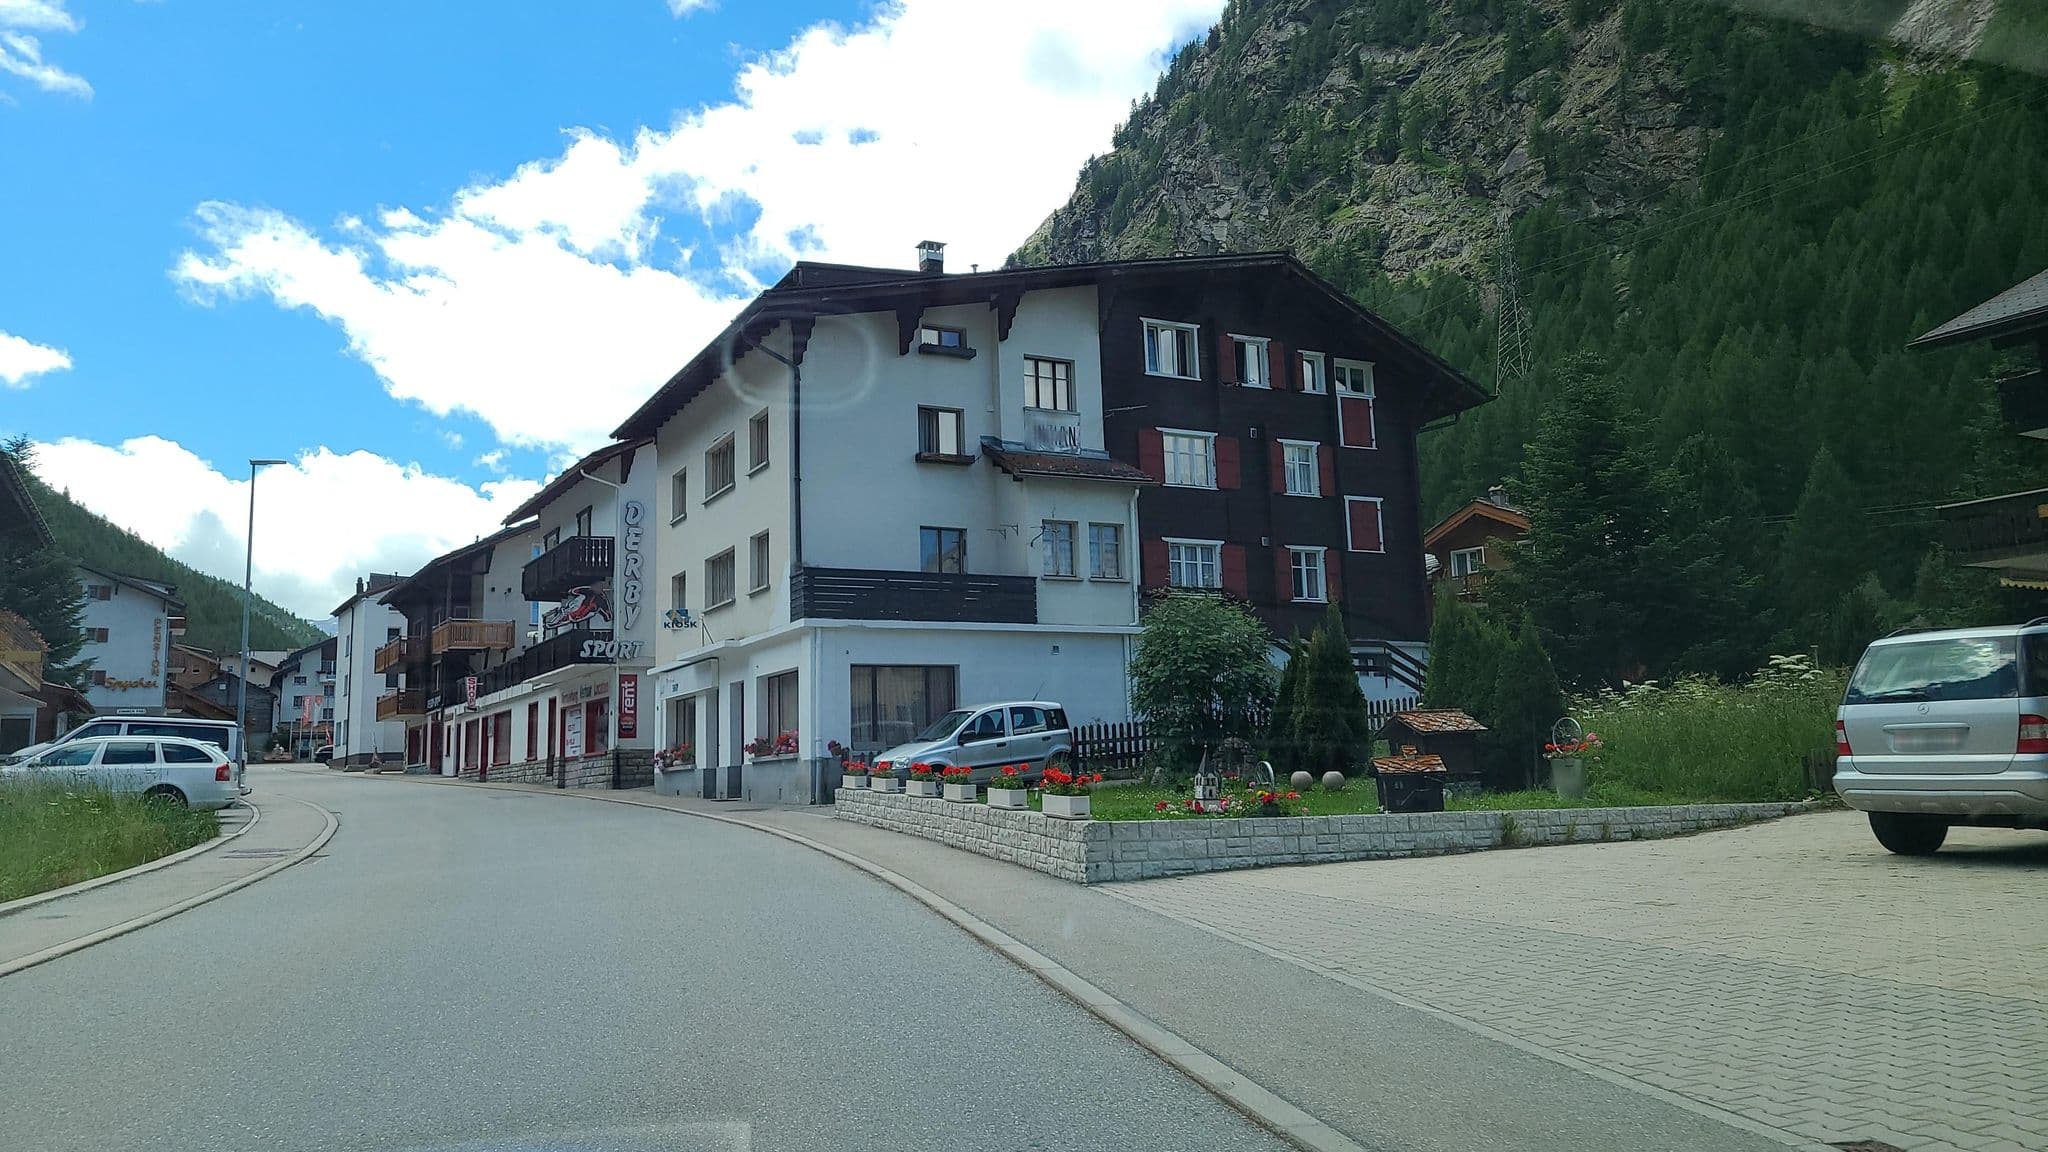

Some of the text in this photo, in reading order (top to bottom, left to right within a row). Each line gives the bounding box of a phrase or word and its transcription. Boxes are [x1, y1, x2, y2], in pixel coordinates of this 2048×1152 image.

[625, 500, 644, 630] DERBY
[664, 621, 697, 629] KIOSK
[152, 618, 161, 677] PENSION
[580, 639, 644, 660] SPORT
[467, 677, 476, 707] SHOP
[621, 681, 635, 714] rent
